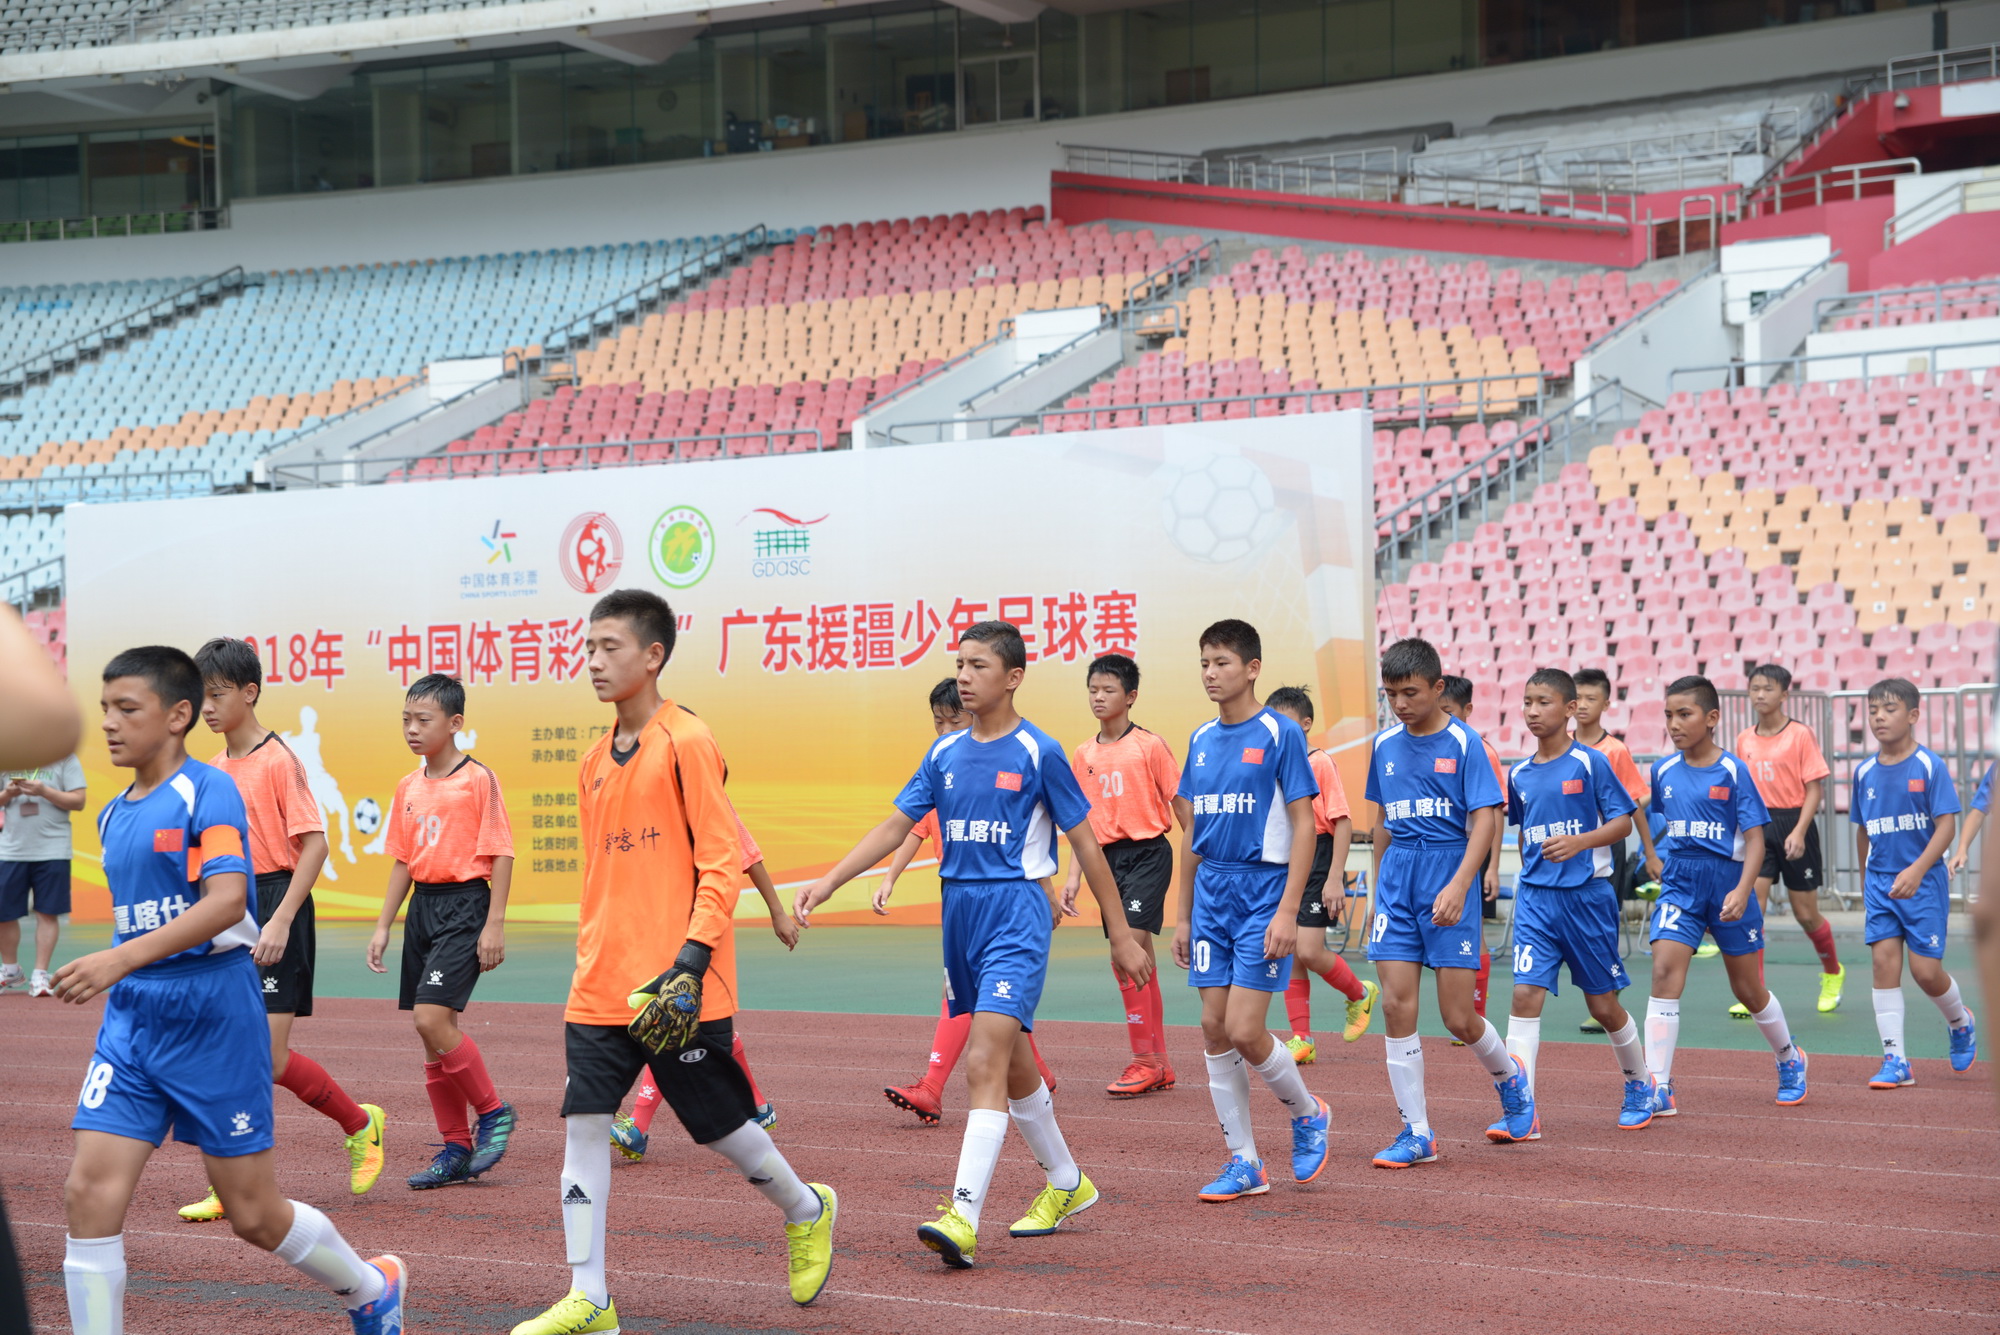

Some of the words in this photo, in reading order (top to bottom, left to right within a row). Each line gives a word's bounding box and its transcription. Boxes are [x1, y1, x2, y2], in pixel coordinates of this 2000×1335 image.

[460, 569, 538, 588] 中国体育彩票
[1098, 771, 1124, 799] 20
[1755, 760, 1775, 782] 15
[415, 814, 441, 847] 18
[1658, 902, 1682, 931] 12
[1512, 944, 1534, 973] 16
